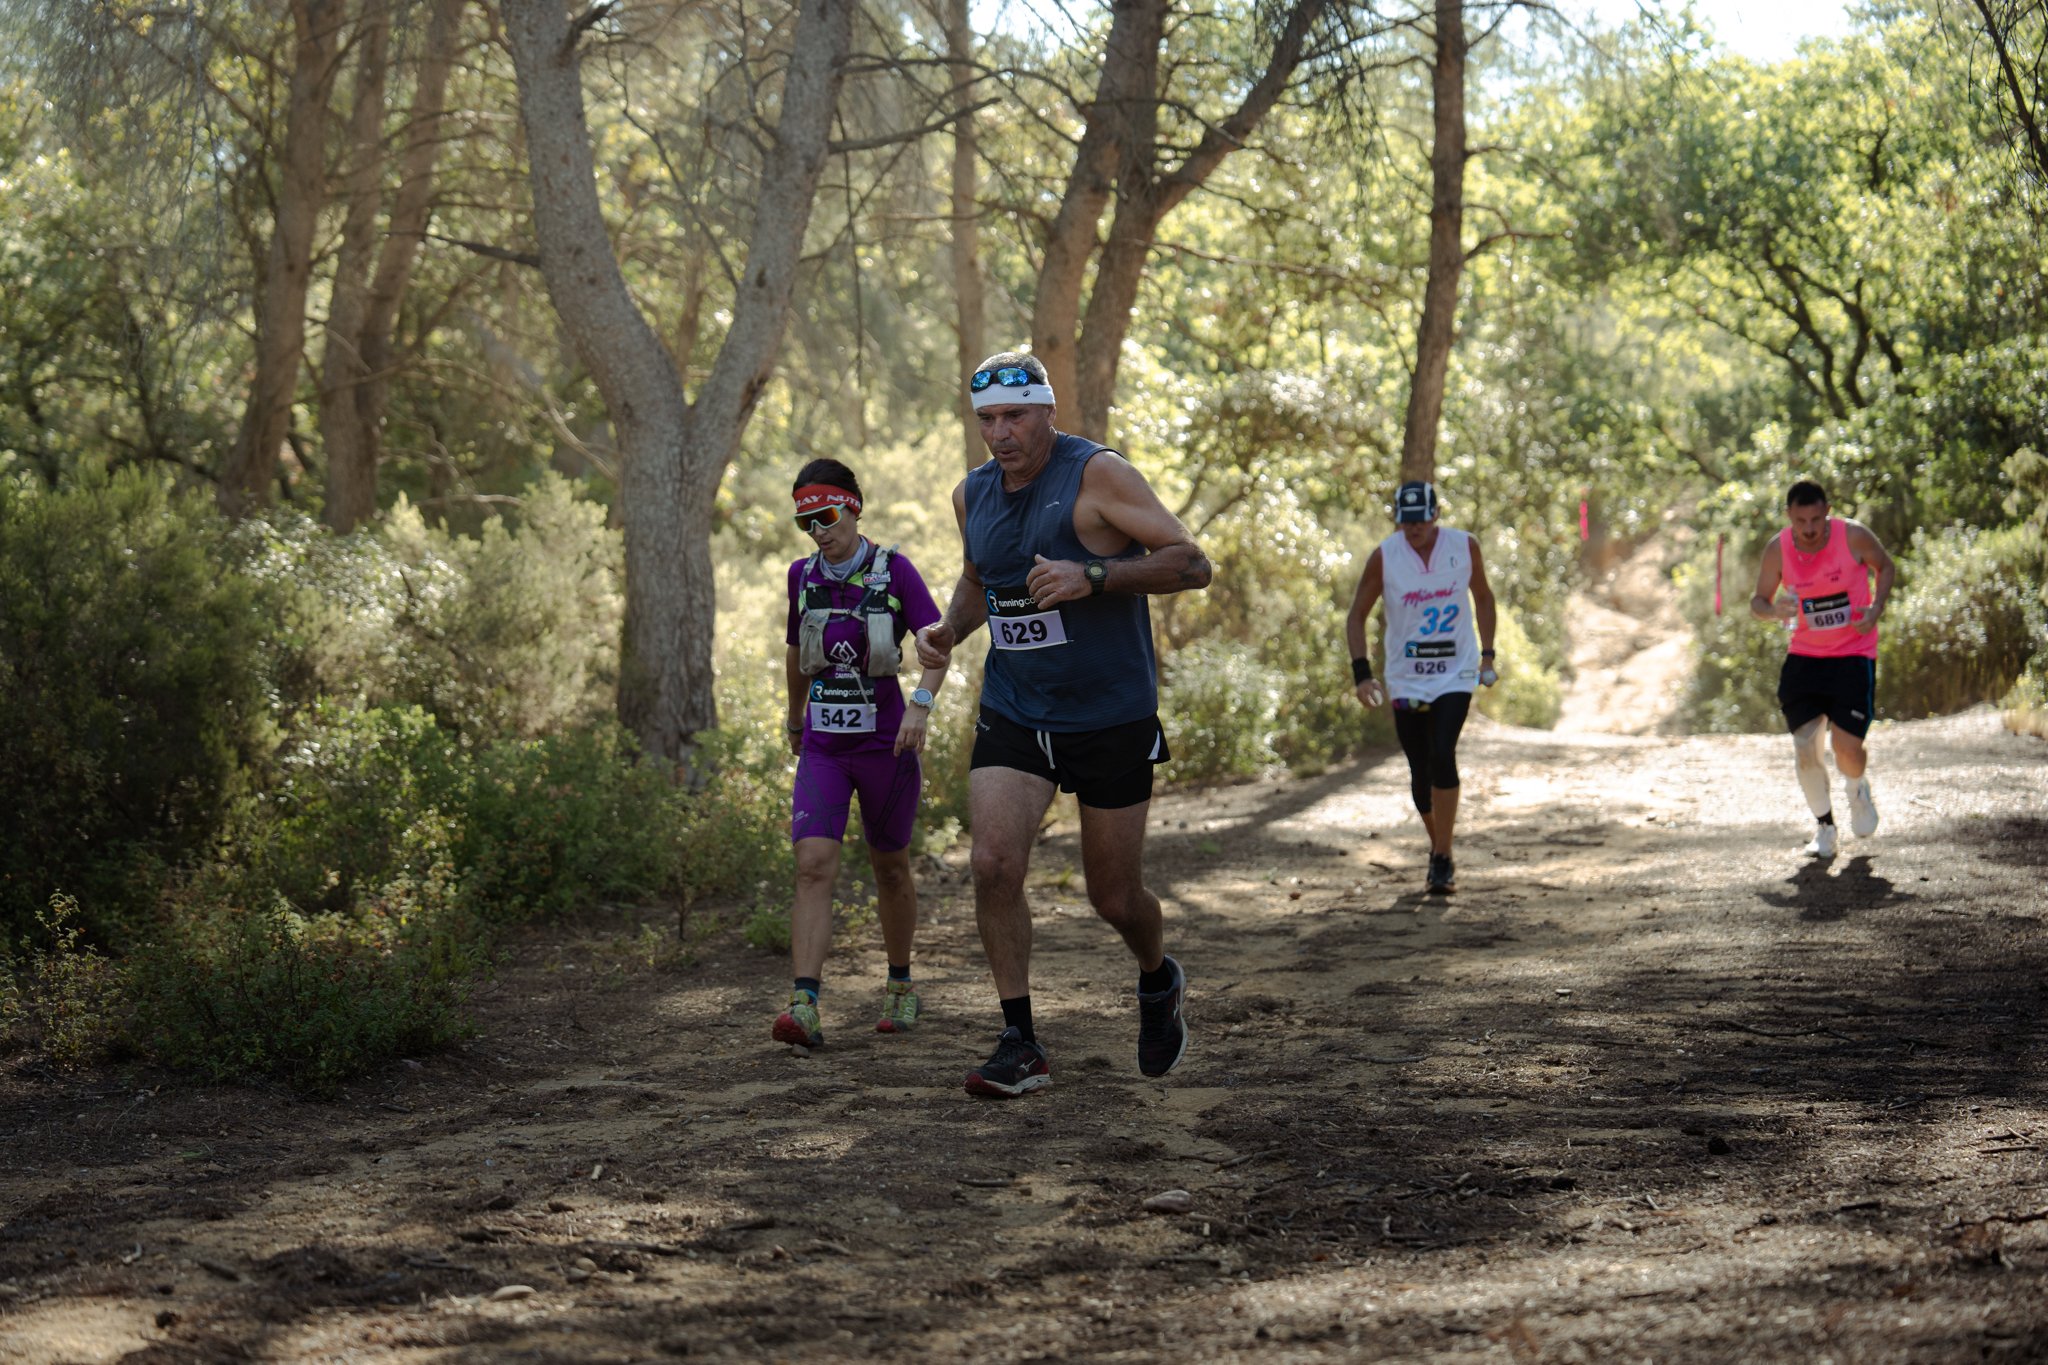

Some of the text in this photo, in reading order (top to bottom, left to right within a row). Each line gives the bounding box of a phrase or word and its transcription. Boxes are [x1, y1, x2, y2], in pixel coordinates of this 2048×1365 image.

[998, 597, 1036, 608] runningco
[1401, 580, 1457, 607] Miami
[1419, 604, 1460, 636] 32
[1814, 611, 1845, 627] 689
[1001, 619, 1048, 645] 629
[1414, 660, 1447, 674] 626
[821, 707, 862, 728] 542
